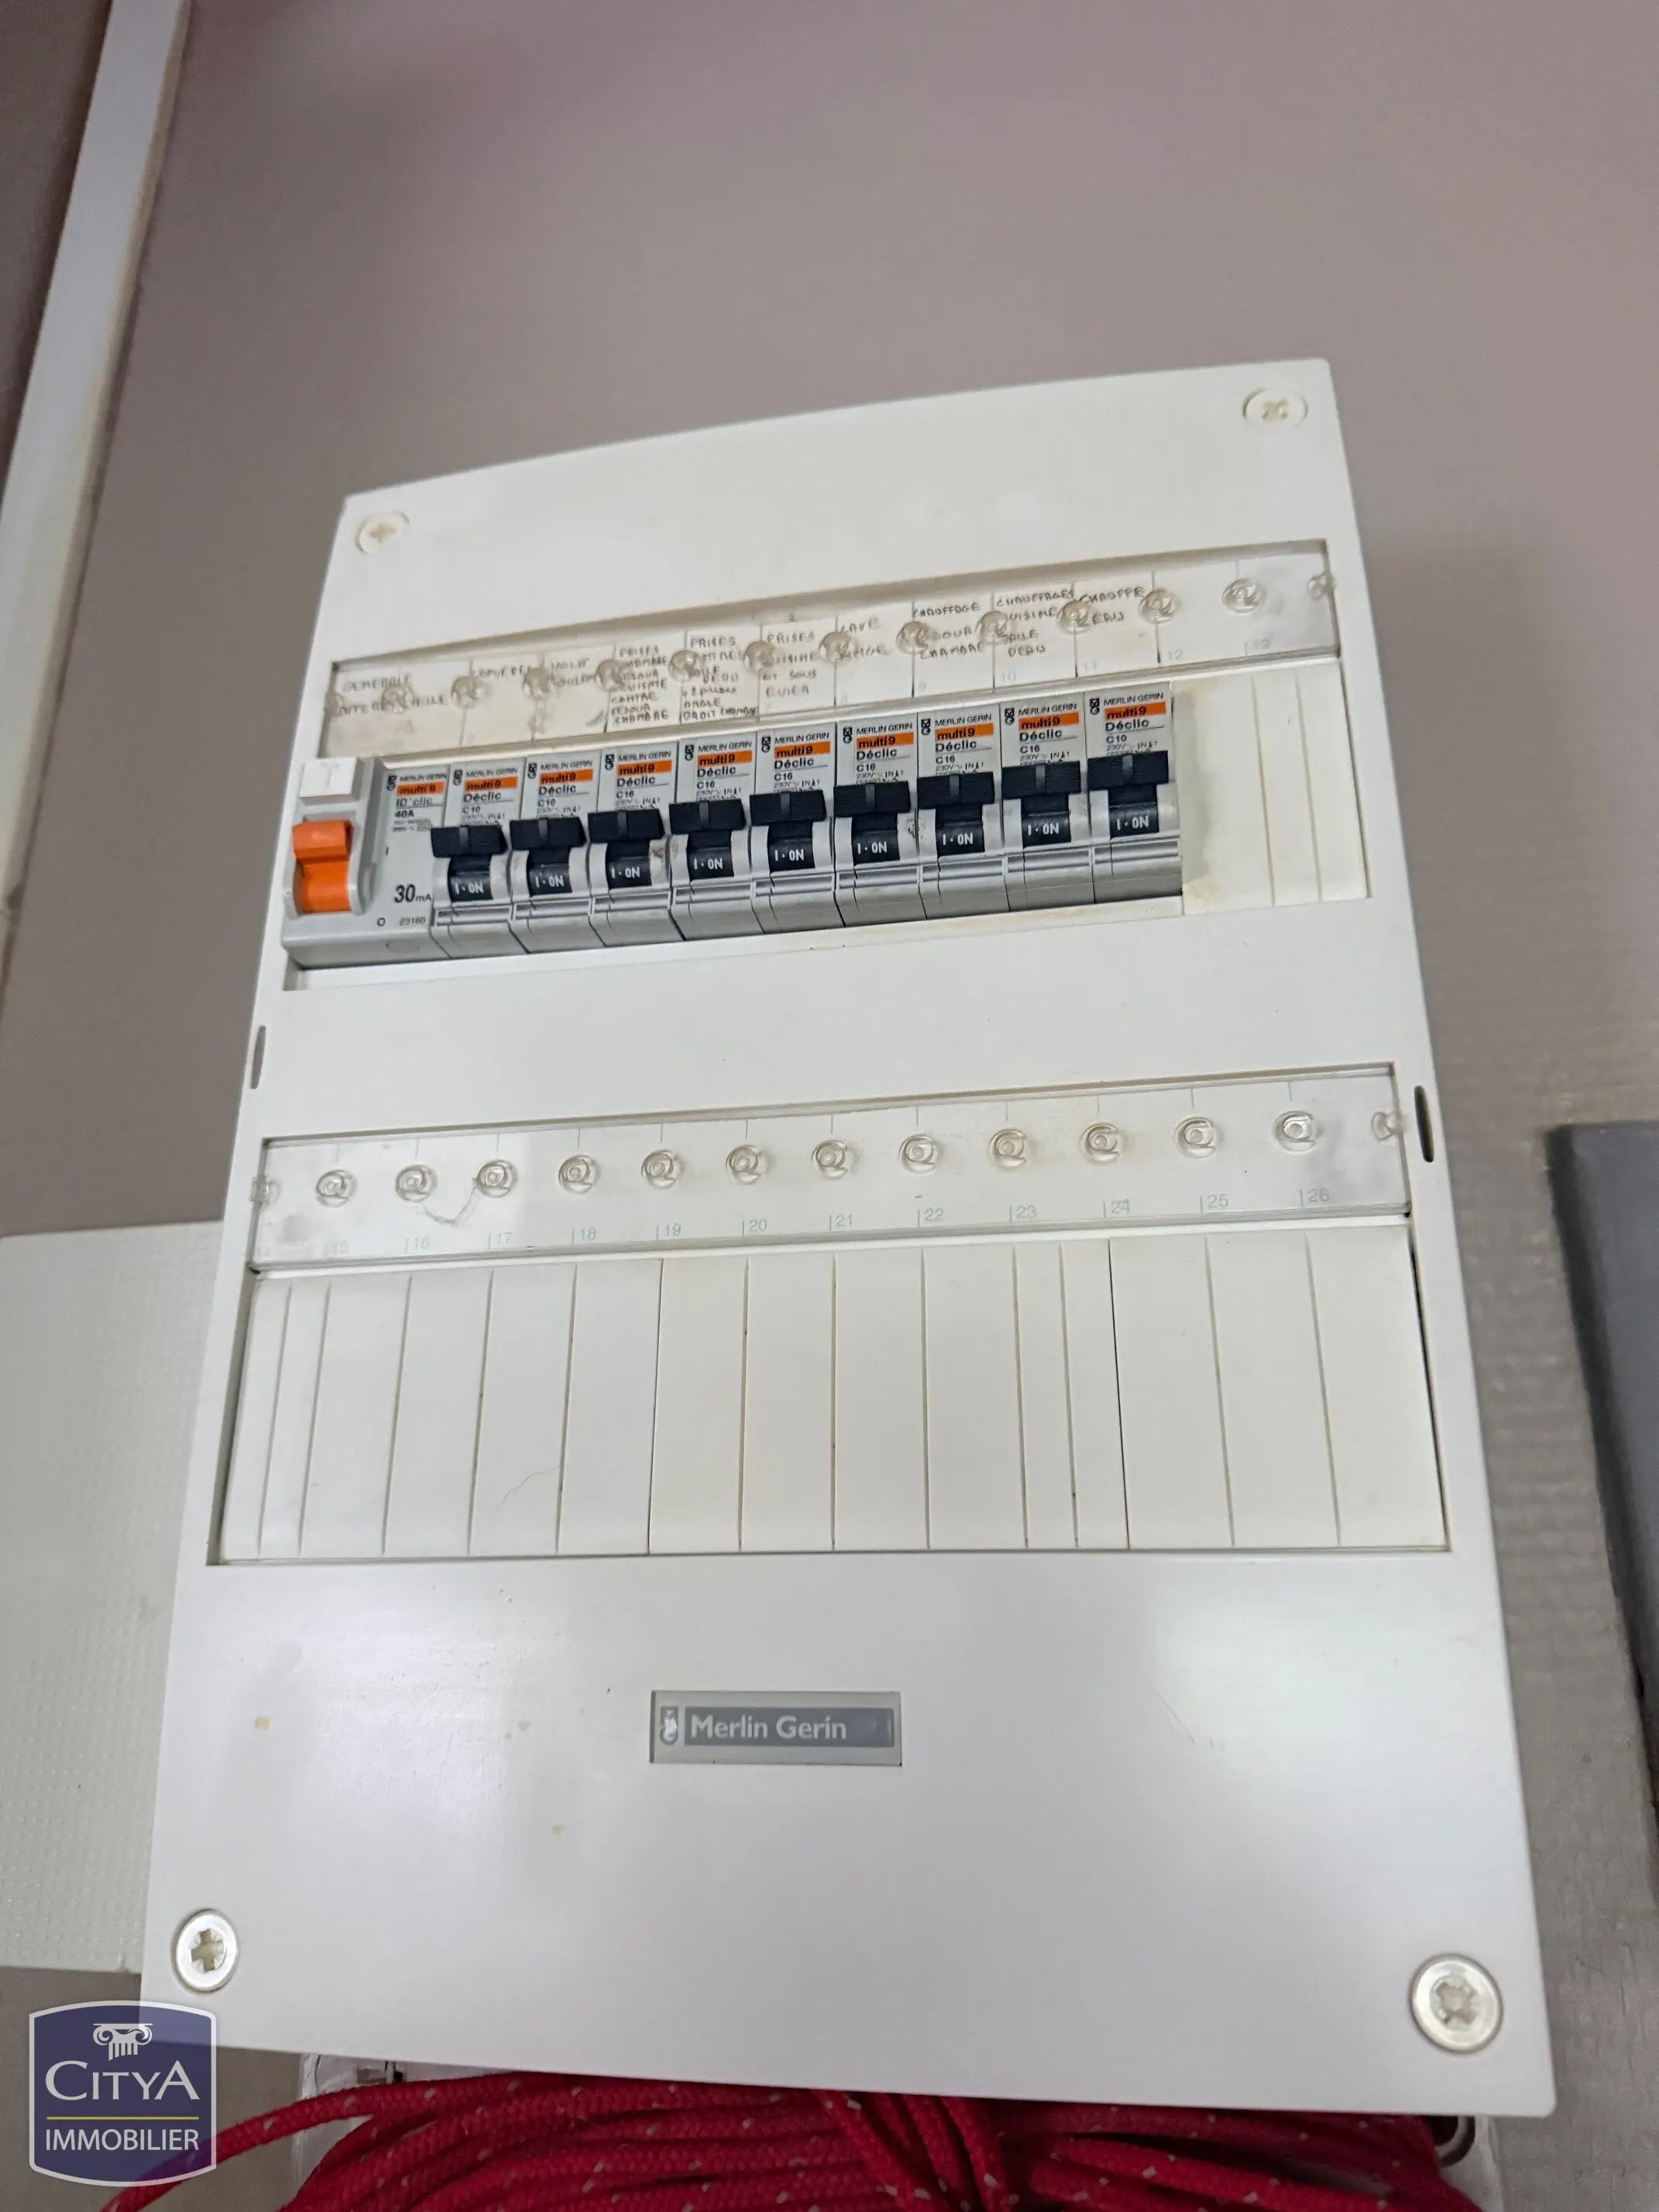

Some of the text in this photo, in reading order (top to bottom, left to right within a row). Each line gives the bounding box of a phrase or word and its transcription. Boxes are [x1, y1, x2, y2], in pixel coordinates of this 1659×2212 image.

[1168, 649, 1183, 661] 12
[1104, 692, 1163, 706] MERLIN GERIN
[1018, 703, 1077, 716] MERLIN GERIN
[935, 714, 991, 726] MERLIN GERIN
[1105, 719, 1149, 732] Déclic
[856, 723, 912, 735] MERLIN GERIN
[1019, 729, 1062, 742] Déclic
[775, 732, 830, 744] MERLIN GERIN
[1106, 734, 1127, 744] C10
[698, 744, 727, 752] MERLIN
[936, 740, 977, 752] Déclic
[1019, 745, 1040, 754] C16
[857, 748, 897, 761] Déclic
[936, 756, 955, 764] C16
[775, 758, 814, 769] Déclic
[857, 764, 875, 772] C16
[697, 767, 737, 778] Déclic
[775, 772, 792, 781] C16
[697, 781, 715, 789] C16
[1207, 1194, 1228, 1209] 25
[1308, 1187, 1331, 1204] 26
[1016, 1205, 1037, 1220] 23
[1111, 1198, 1131, 1214] 24
[836, 1214, 853, 1228] 21
[924, 1207, 944, 1222] 22
[665, 1223, 682, 1237] 19
[748, 1218, 768, 1232] 20
[497, 1231, 513, 1245] 17
[579, 1228, 597, 1241] 18
[691, 1714, 847, 1740] Merlin Gerin
